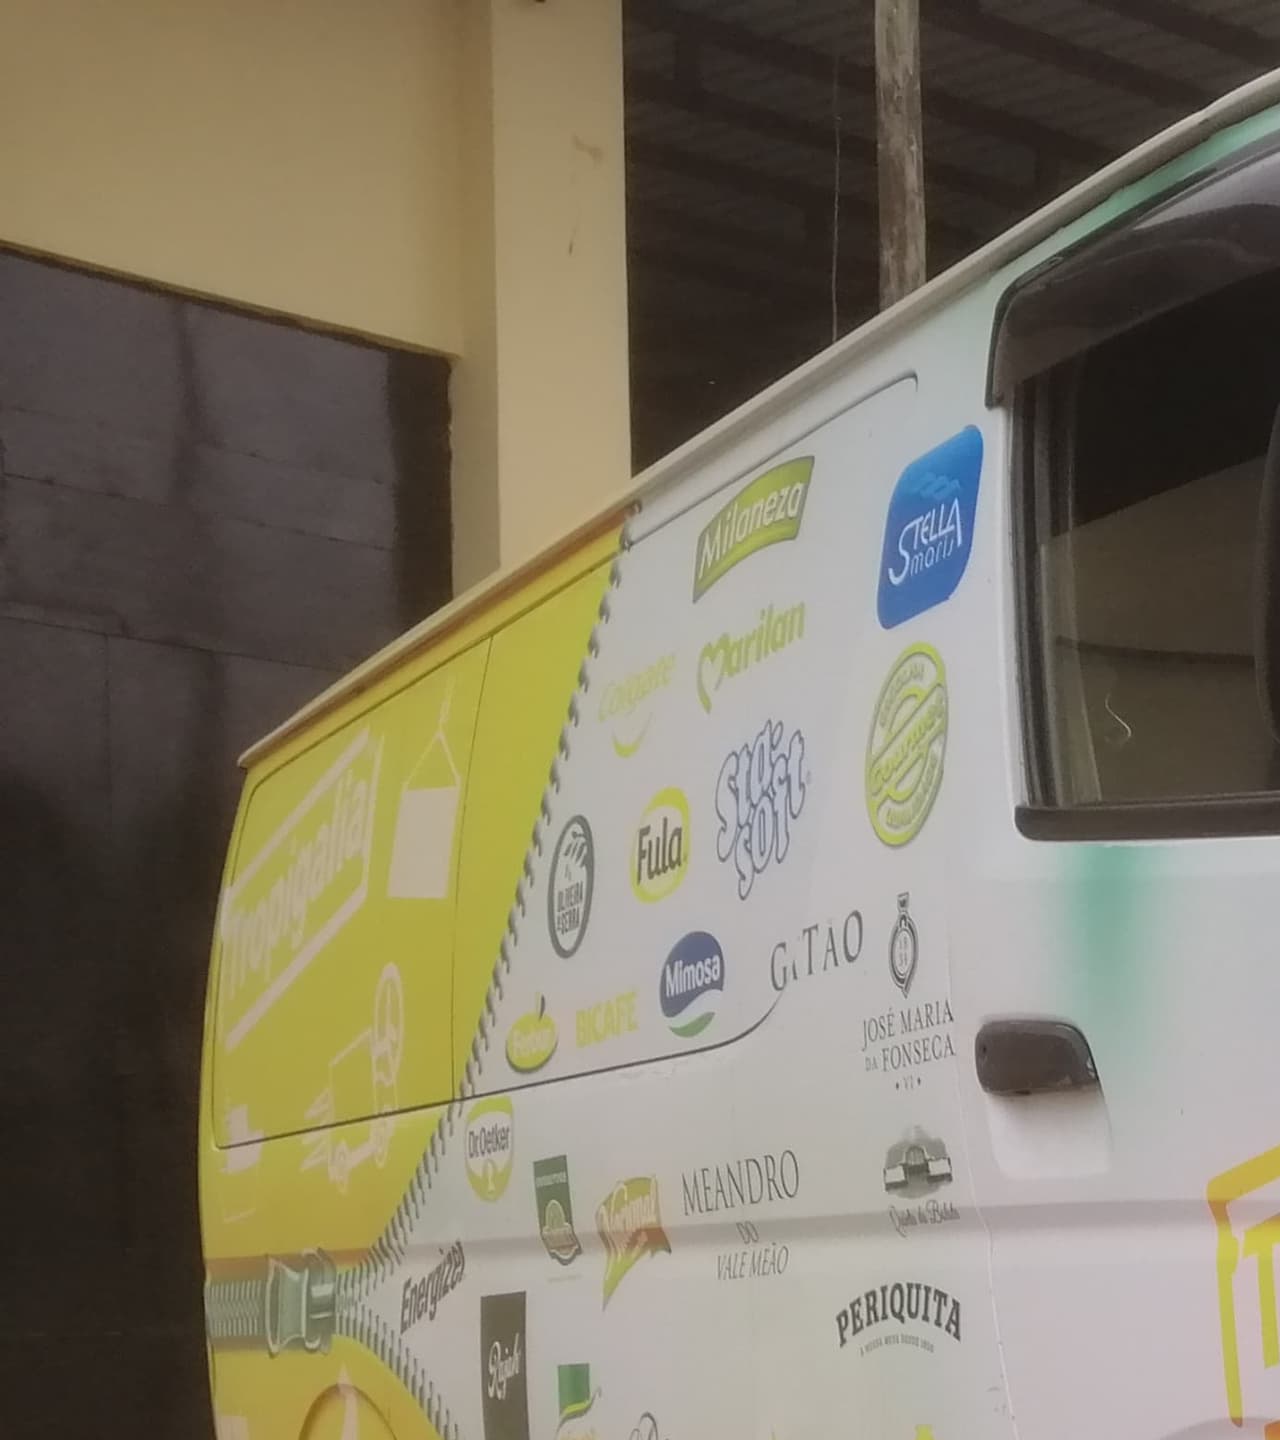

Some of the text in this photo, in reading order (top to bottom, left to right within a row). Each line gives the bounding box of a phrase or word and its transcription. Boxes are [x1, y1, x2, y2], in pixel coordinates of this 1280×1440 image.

[698, 482, 806, 580] Milaneza
[887, 497, 963, 585] STELLA
[909, 535, 955, 577] maris
[636, 816, 683, 886] Fula
[665, 954, 721, 999] Mimosa
[862, 998, 955, 1052] JOSÉ MARIA
[881, 1031, 957, 1073] FONSECA
[682, 1148, 800, 1217] MEANDRO
[716, 1242, 790, 1281] VALE MEÃO
[735, 1220, 760, 1246] DO
[400, 1239, 466, 1335] Energizer
[836, 1282, 961, 1348] PERIQUITA
